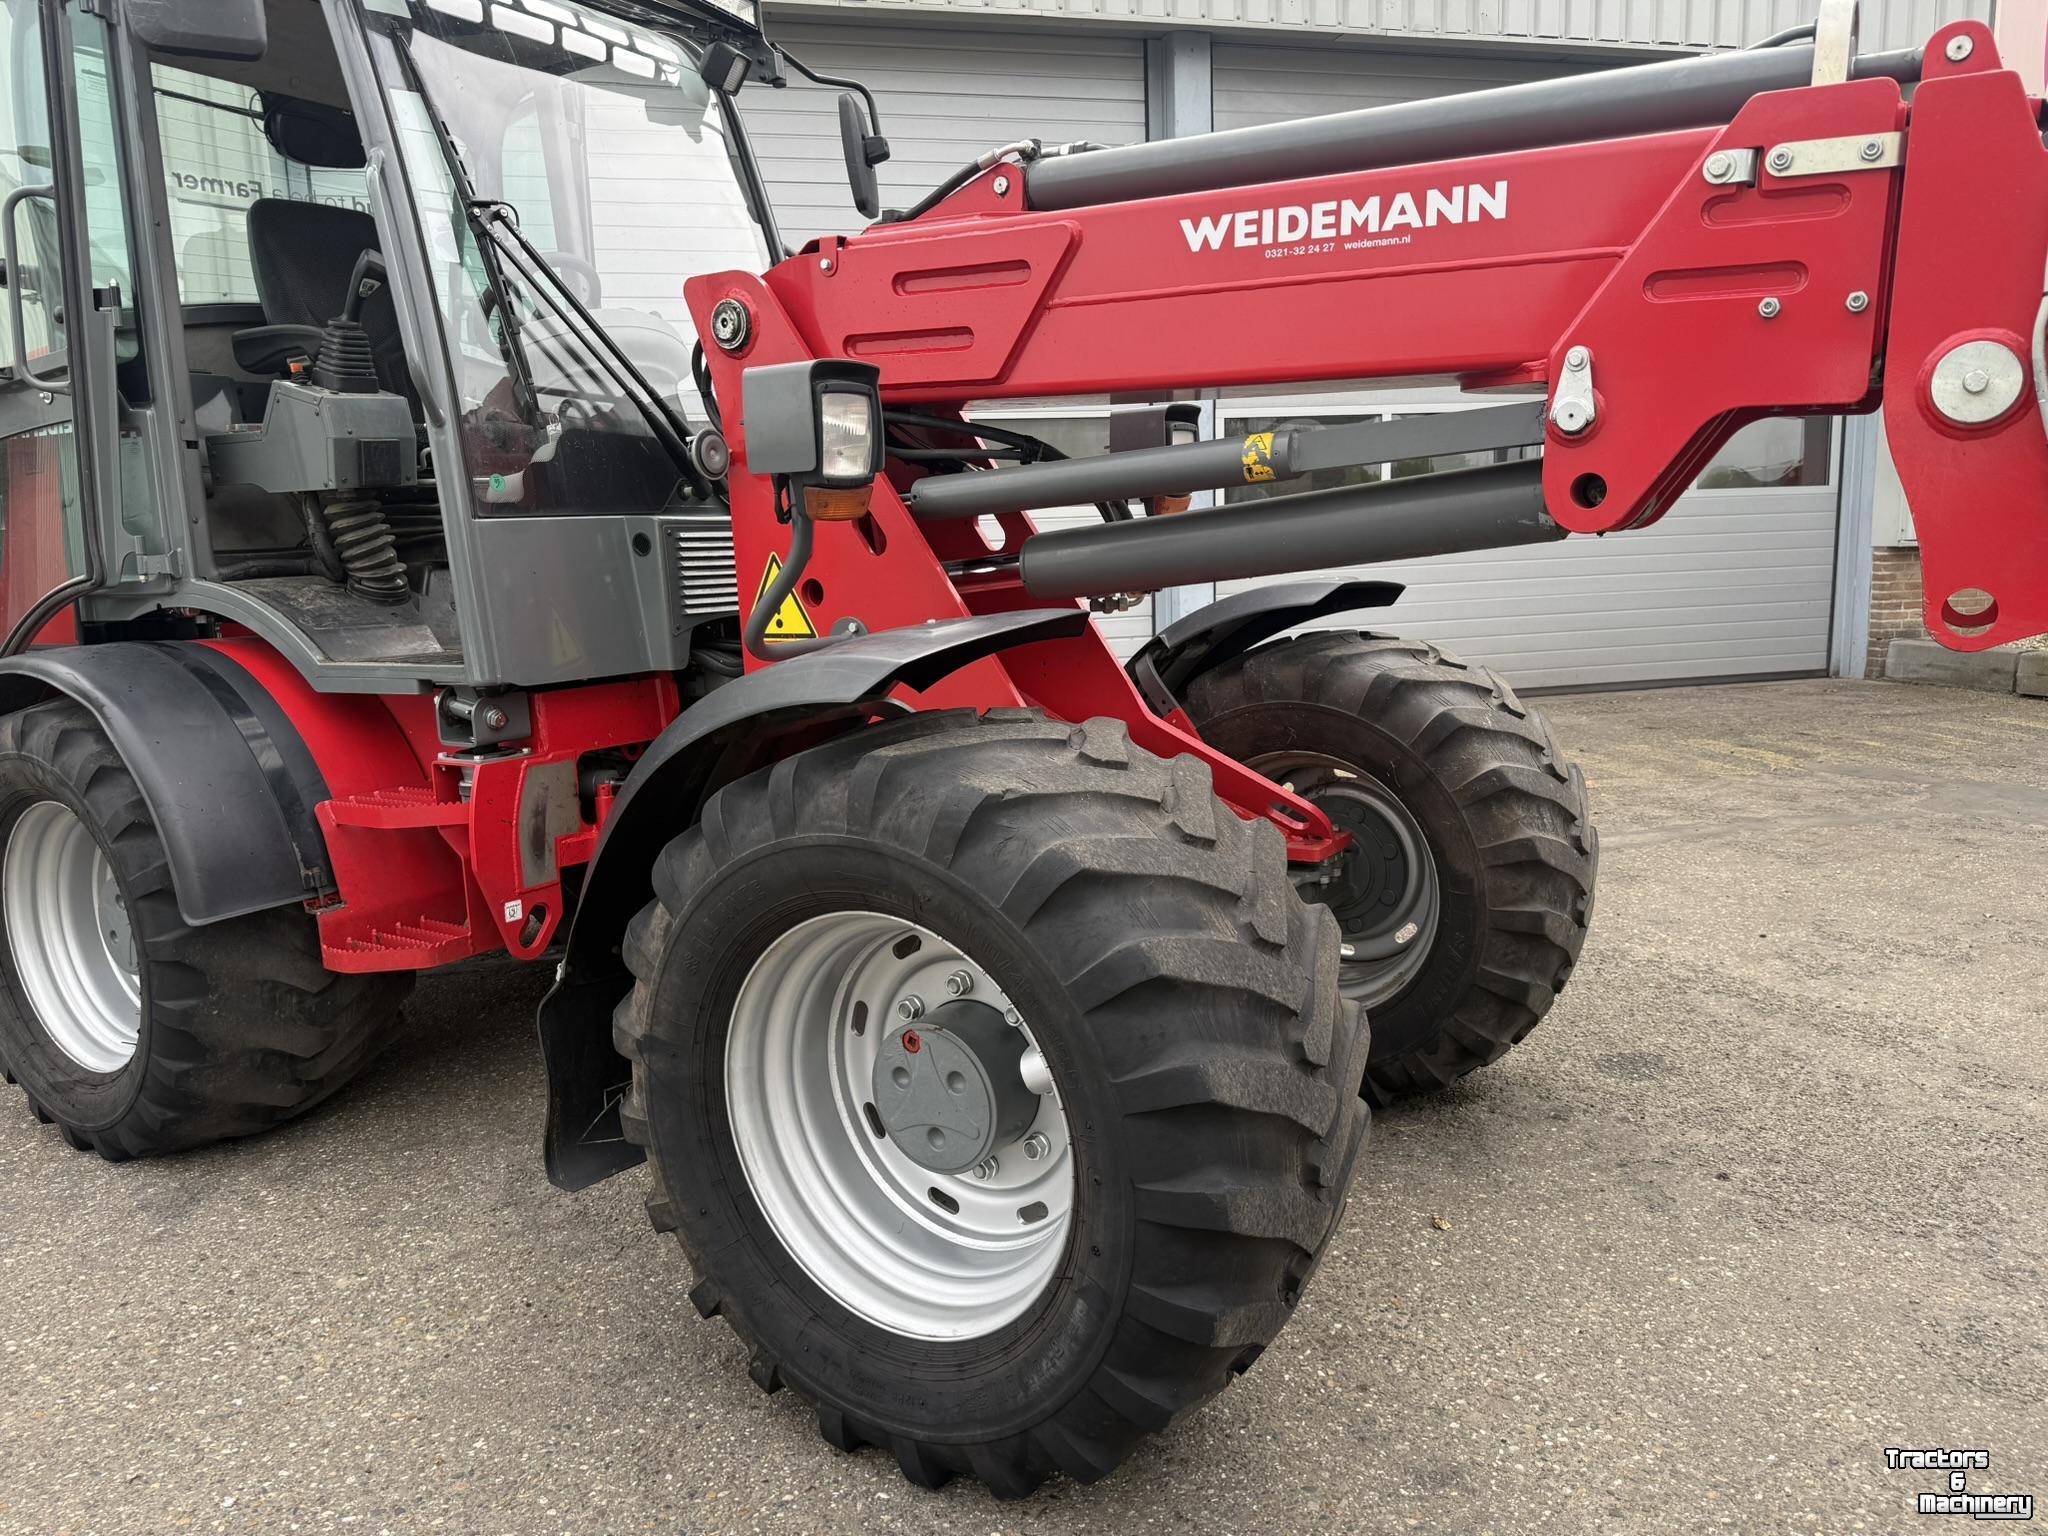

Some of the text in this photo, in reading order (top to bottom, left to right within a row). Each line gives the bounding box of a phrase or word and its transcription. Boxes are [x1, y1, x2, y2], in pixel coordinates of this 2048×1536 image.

[1179, 180, 1508, 253] WEIDEMANN
[1265, 235, 1411, 259] 0321-32 24 27 weidemann.nl
